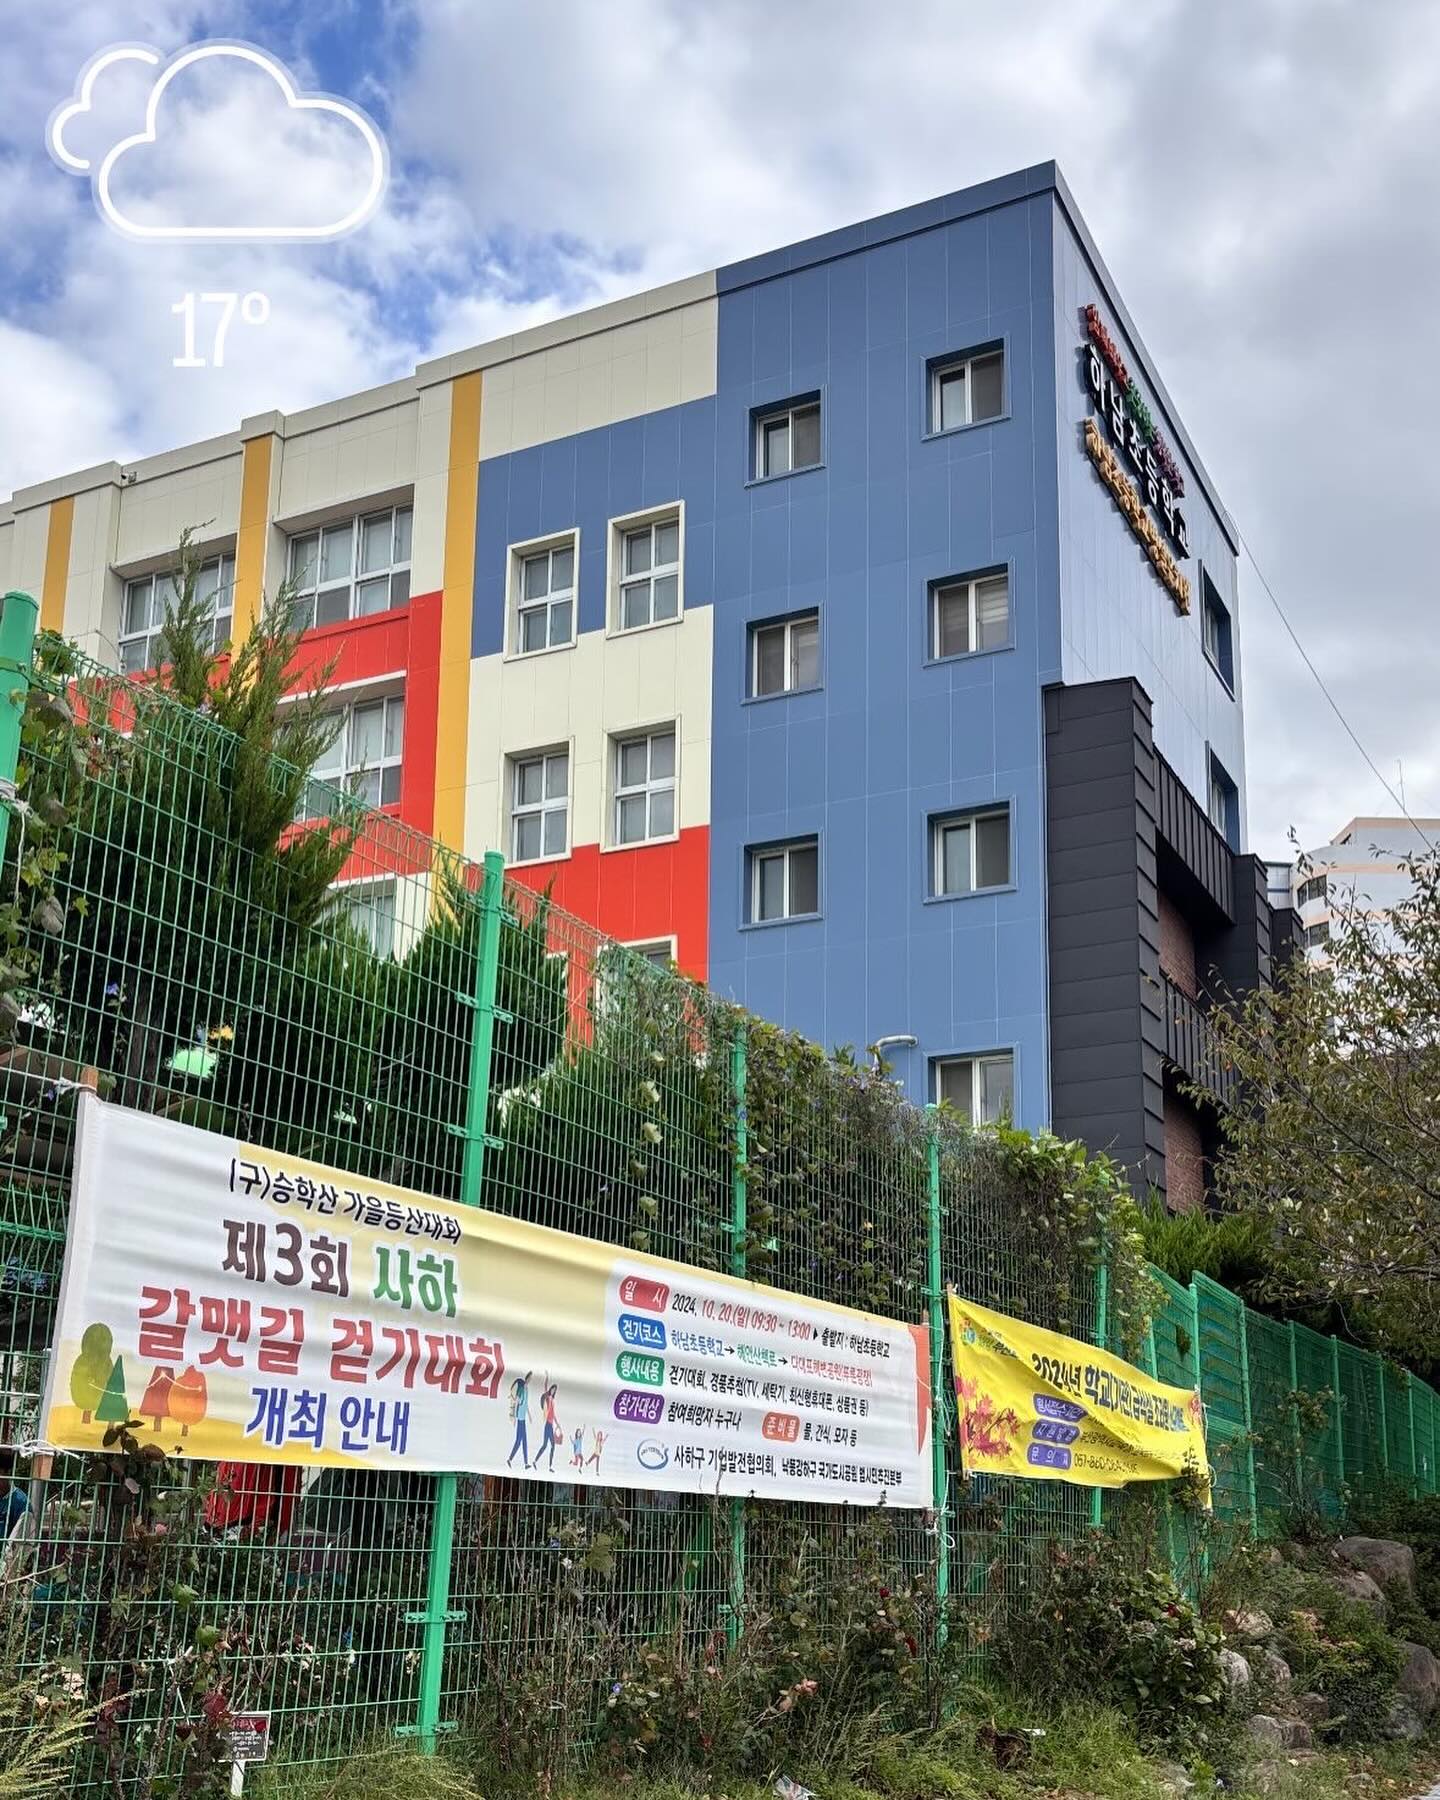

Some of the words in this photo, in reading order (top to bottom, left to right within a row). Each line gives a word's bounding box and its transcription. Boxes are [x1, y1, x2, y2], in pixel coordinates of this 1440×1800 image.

[1085, 343, 1189, 559] 하남초등학교
[230, 1158, 339, 1214] (구)승학산
[344, 1190, 462, 1245] 가을등산대회
[222, 1218, 351, 1298] 제3회
[373, 1247, 458, 1318] 사하
[138, 1286, 305, 1375] 갈맷길
[329, 1319, 505, 1400] 걷기대회
[623, 1319, 663, 1344] 걷기코스
[671, 1329, 725, 1357] 하남초등학교
[751, 1311, 777, 1333] 09:30
[788, 1319, 811, 1340] 13:00
[850, 1334, 890, 1358] 하남초등학교
[621, 1355, 660, 1382] 행사내용
[619, 1393, 660, 1420] 참가대상
[669, 1365, 707, 1391] 걷기대회,
[836, 1395, 857, 1415] 상품권
[246, 1387, 325, 1447] 개최
[339, 1396, 411, 1454] 안내
[668, 1401, 714, 1428] 참여희망자
[715, 1409, 742, 1431] 누구나
[834, 1427, 848, 1446] 모자
[850, 1429, 857, 1447] 등
[674, 1445, 705, 1469] 사하구
[782, 1458, 816, 1478] 낙동강하구
[818, 1461, 858, 1482] 국가도시공원
